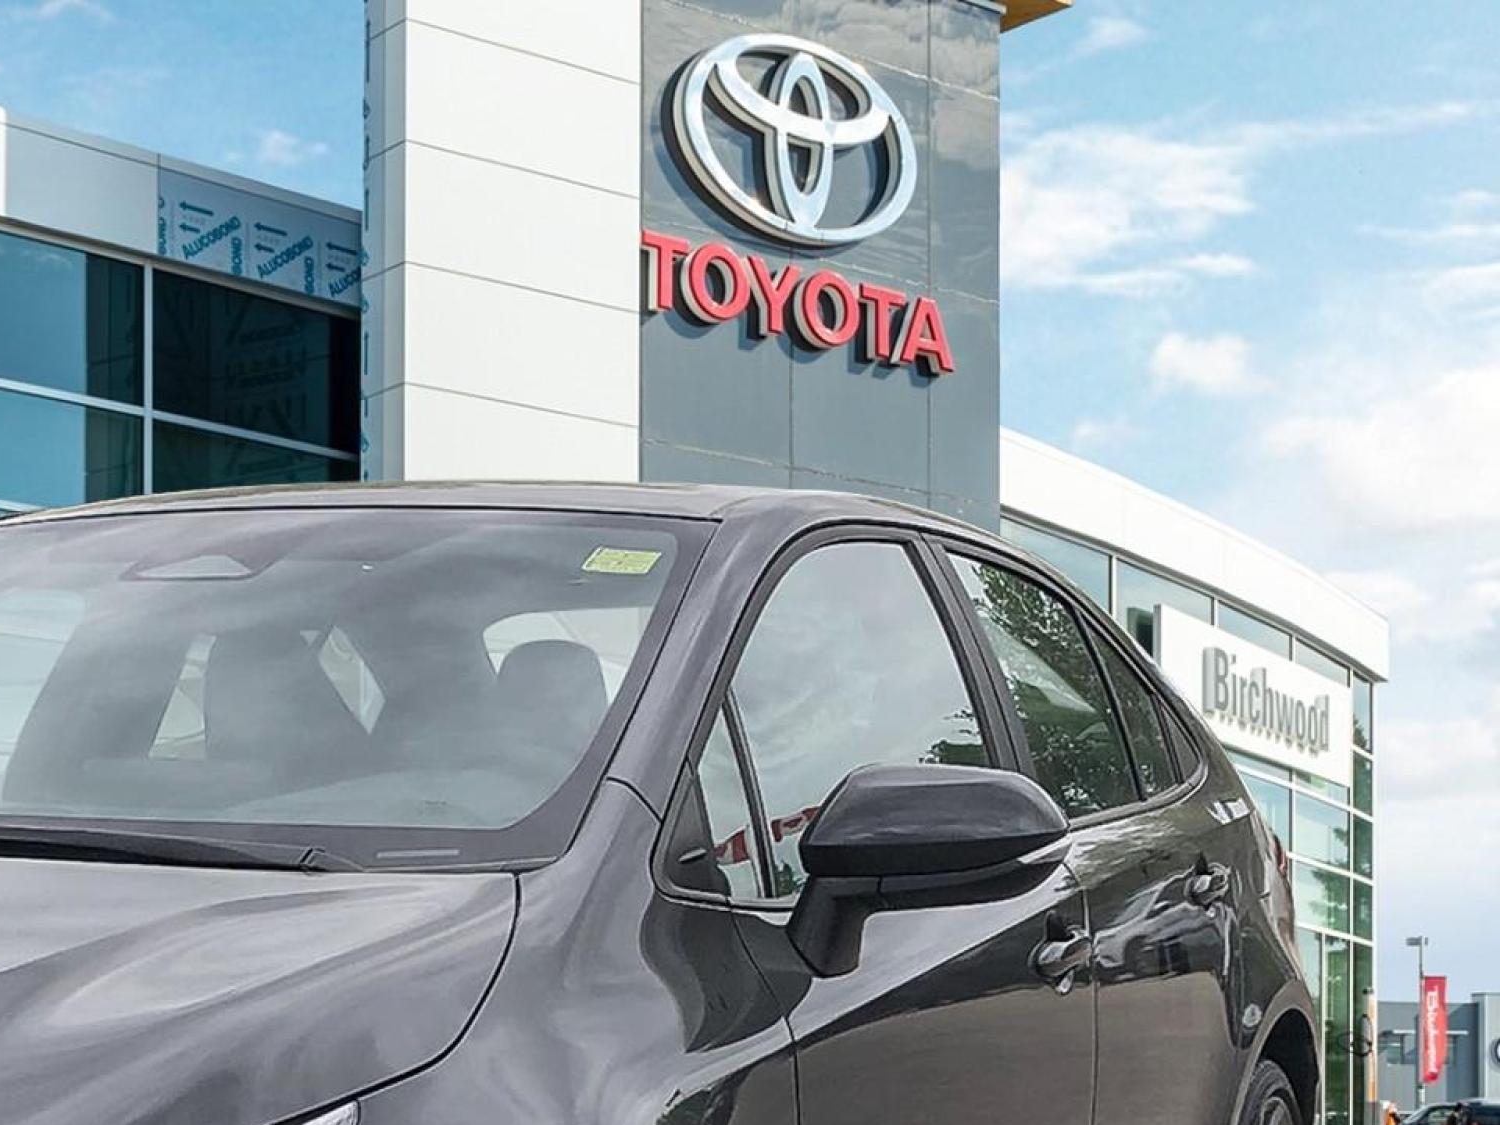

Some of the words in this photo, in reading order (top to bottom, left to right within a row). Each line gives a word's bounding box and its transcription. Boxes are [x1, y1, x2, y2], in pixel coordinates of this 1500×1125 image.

[181, 216, 241, 260] ALUCOBOND
[257, 236, 314, 279] ALUCOBOND
[641, 230, 954, 373] TOYOTA
[1202, 647, 1329, 753] Birchwood
